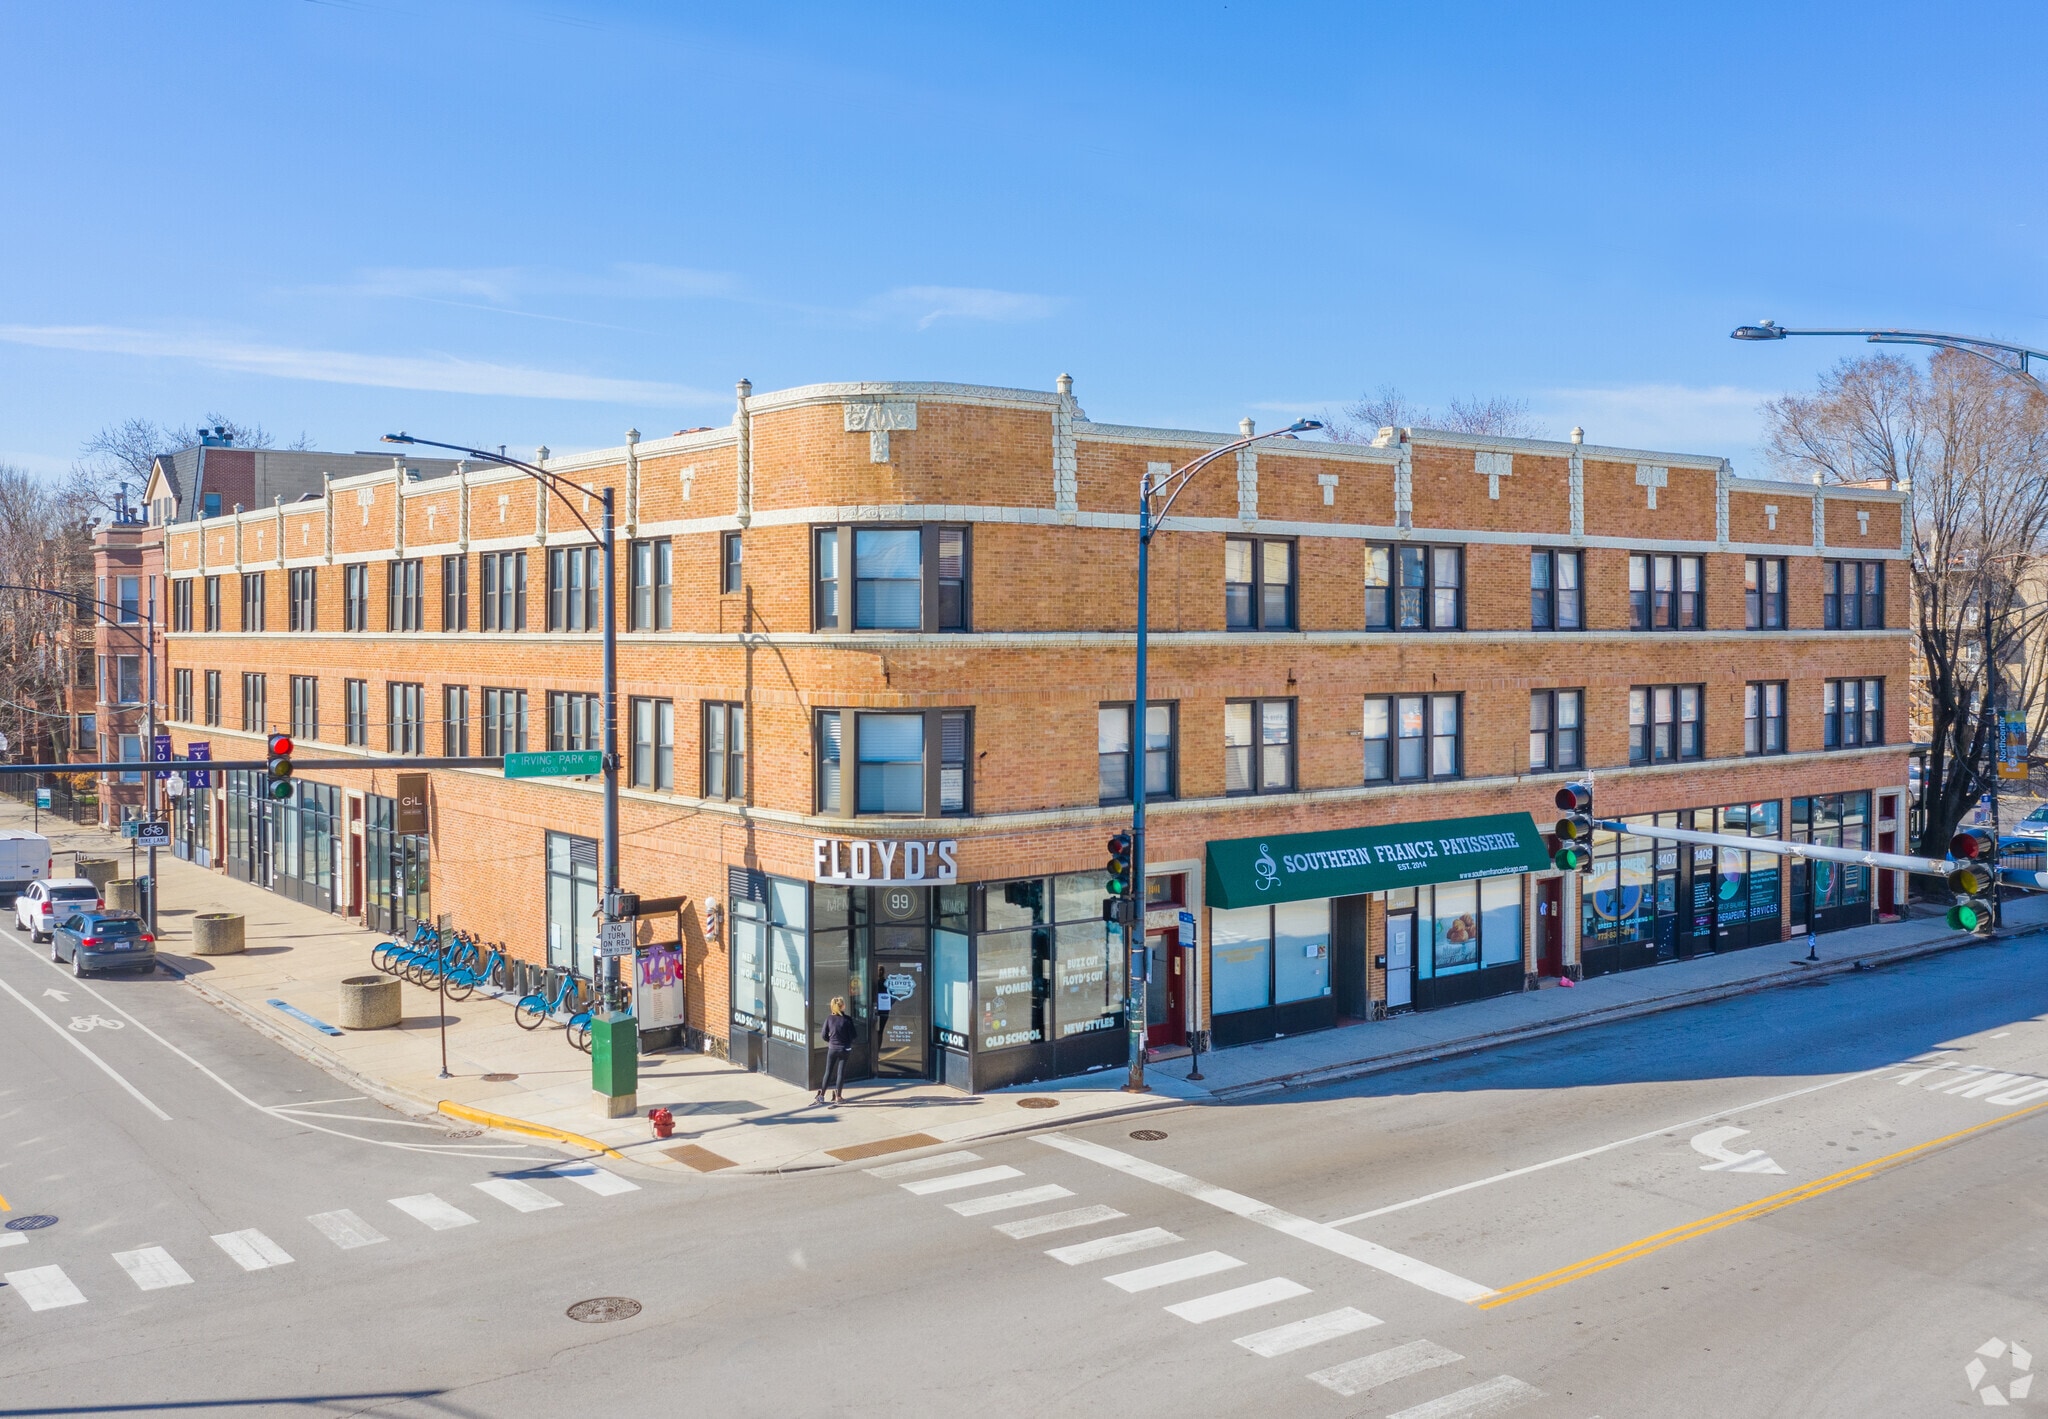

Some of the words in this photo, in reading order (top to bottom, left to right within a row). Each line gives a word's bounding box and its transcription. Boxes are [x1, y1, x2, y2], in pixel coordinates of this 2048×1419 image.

[157, 745, 166, 777] YOA
[521, 755, 552, 766] IRVING
[558, 754, 584, 765] PARK
[195, 752, 204, 786] YGA
[540, 766, 559, 774] 4000
[1283, 847, 1371, 873] SOUTHERN
[1374, 841, 1437, 863] FRANCE
[1439, 832, 1520, 856] PATISSERIE
[1659, 853, 1677, 865] 1407
[1694, 848, 1713, 861] 1409
[813, 839, 958, 881] FLOYD'S
[1397, 863, 1411, 871] EST.
[1412, 861, 1427, 869] 2014
[891, 894, 909, 909] 99
[1750, 903, 1778, 917] SERVICES
[610, 924, 623, 933] NO
[603, 940, 613, 948] ON
[617, 938, 630, 947] RED
[607, 932, 626, 940] TURN
[1067, 957, 1086, 969] BUZZ
[1086, 956, 1099, 967] CUT
[999, 967, 1020, 979] MEN
[1063, 972, 1091, 986] FLOYD'S
[1091, 970, 1104, 982] CUT
[995, 980, 1033, 996] WOMEN
[1063, 1021, 1085, 1035] NEW
[1085, 1017, 1115, 1031] STYLES
[772, 1025, 786, 1038] NEW
[786, 1028, 806, 1044] STYLES
[940, 1031, 964, 1047] COLOR
[985, 1035, 1005, 1048] OLD
[1005, 1029, 1042, 1044] SCHOOL
